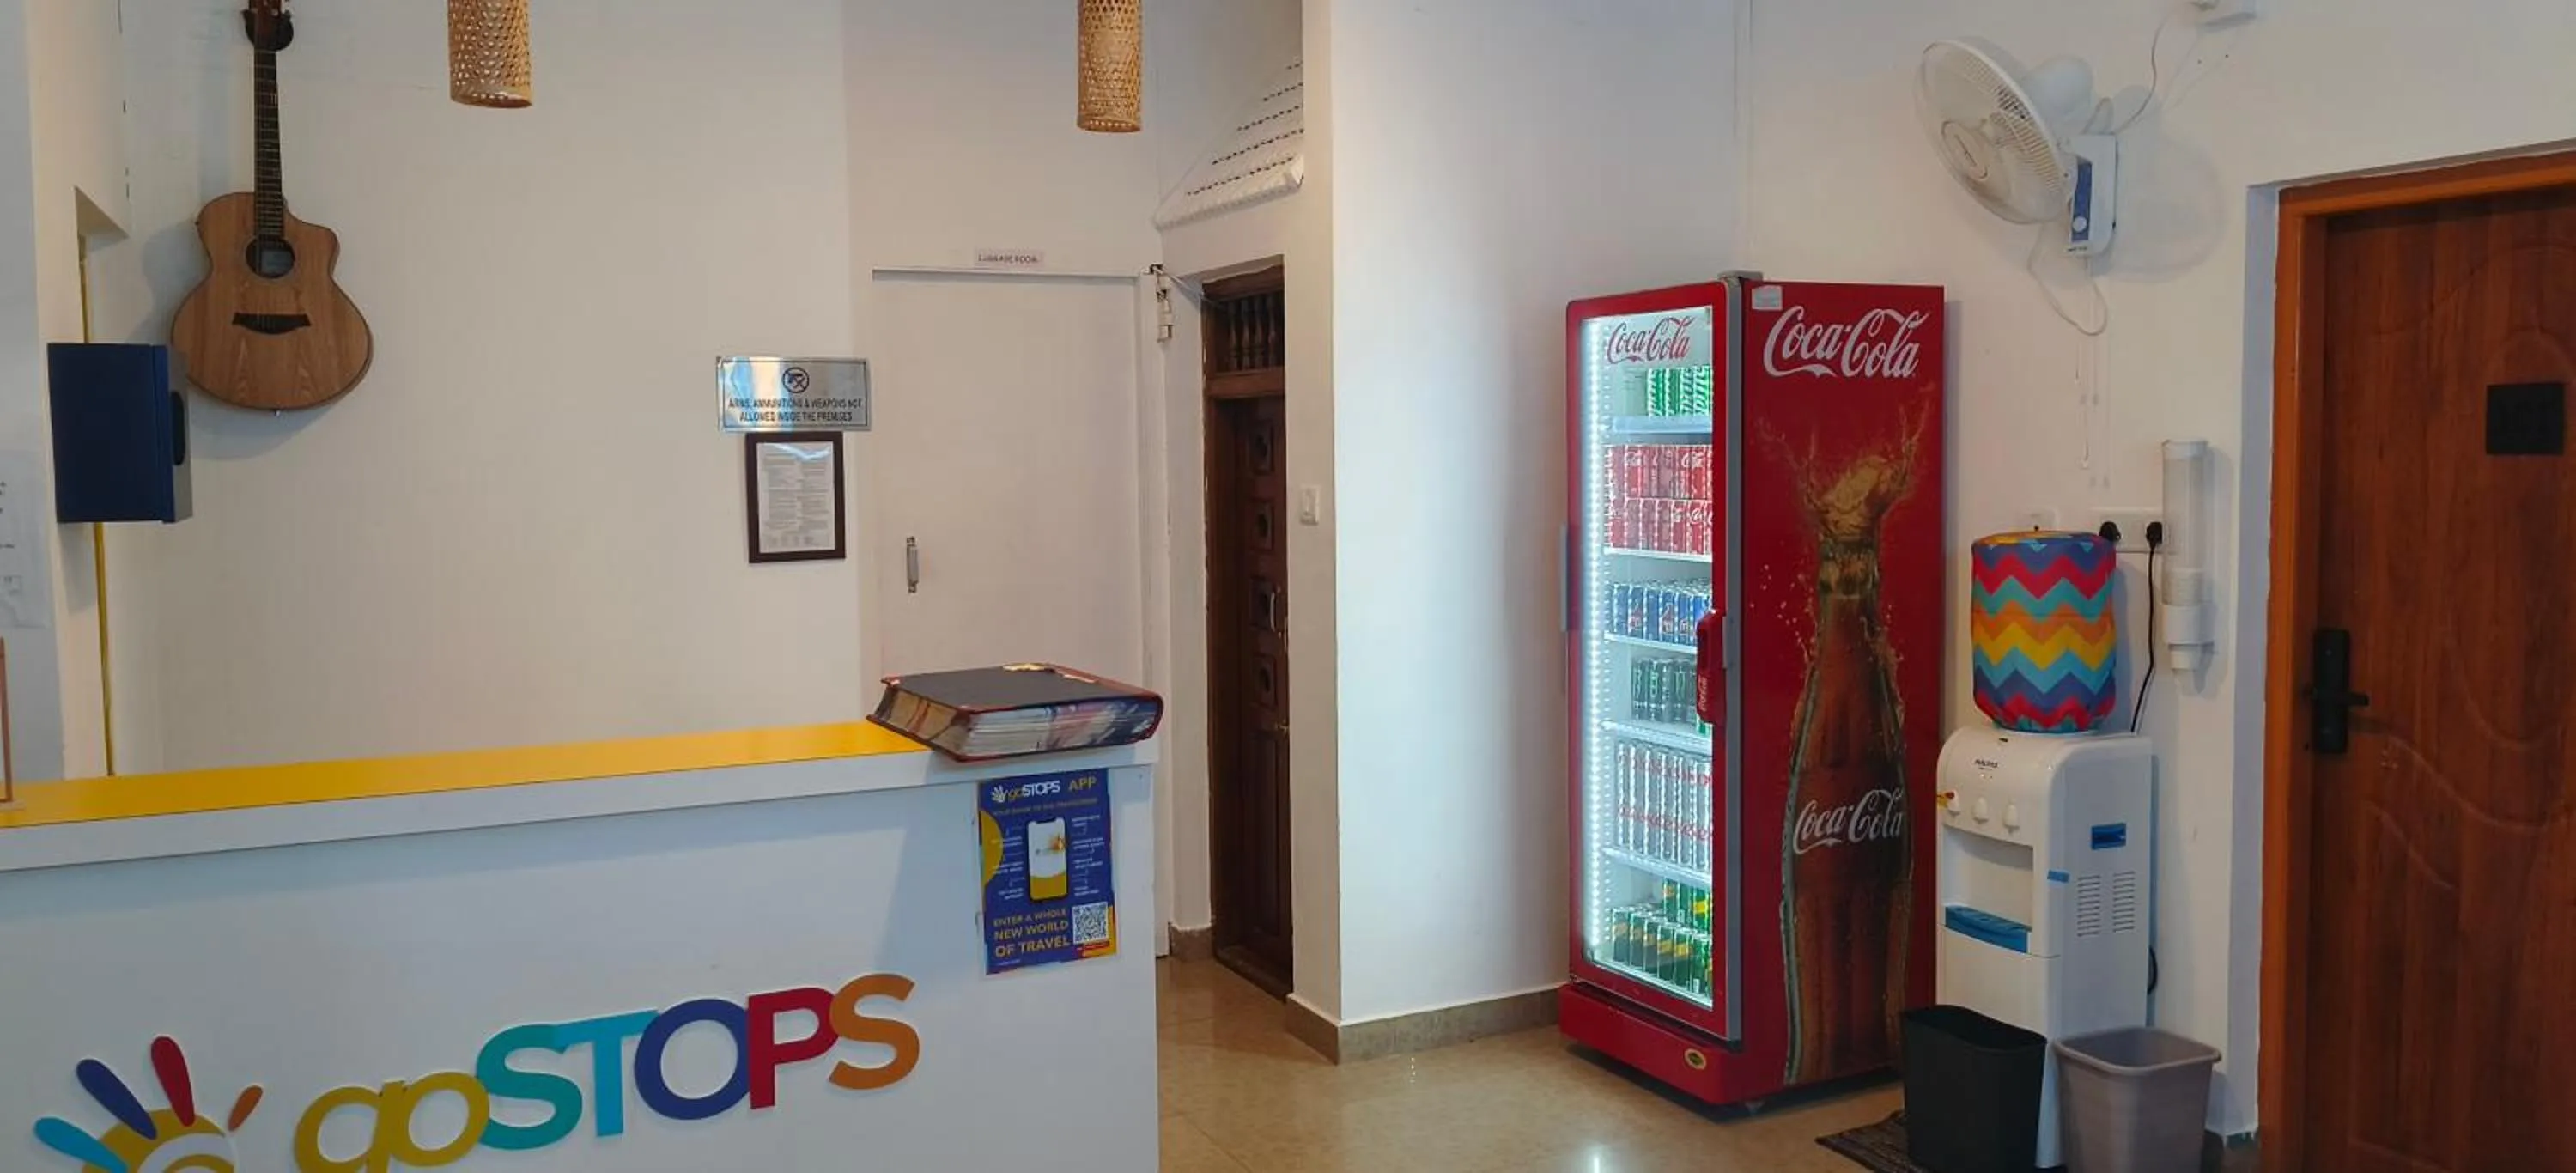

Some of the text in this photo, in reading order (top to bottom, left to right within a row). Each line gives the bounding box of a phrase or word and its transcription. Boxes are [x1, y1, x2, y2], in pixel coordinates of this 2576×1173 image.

[1607, 315, 1696, 364] Coca-Cola
[1763, 305, 1930, 379] Coca-Cola
[1068, 776, 1097, 793] APP
[1793, 787, 1904, 855] Coca-Cola
[993, 915, 1024, 927] ENTER
[993, 919, 1069, 941] NEW WORLD
[995, 944, 1015, 959] OF
[1018, 935, 1072, 955] TRAVEL
[294, 973, 920, 1173] goSTOPS
